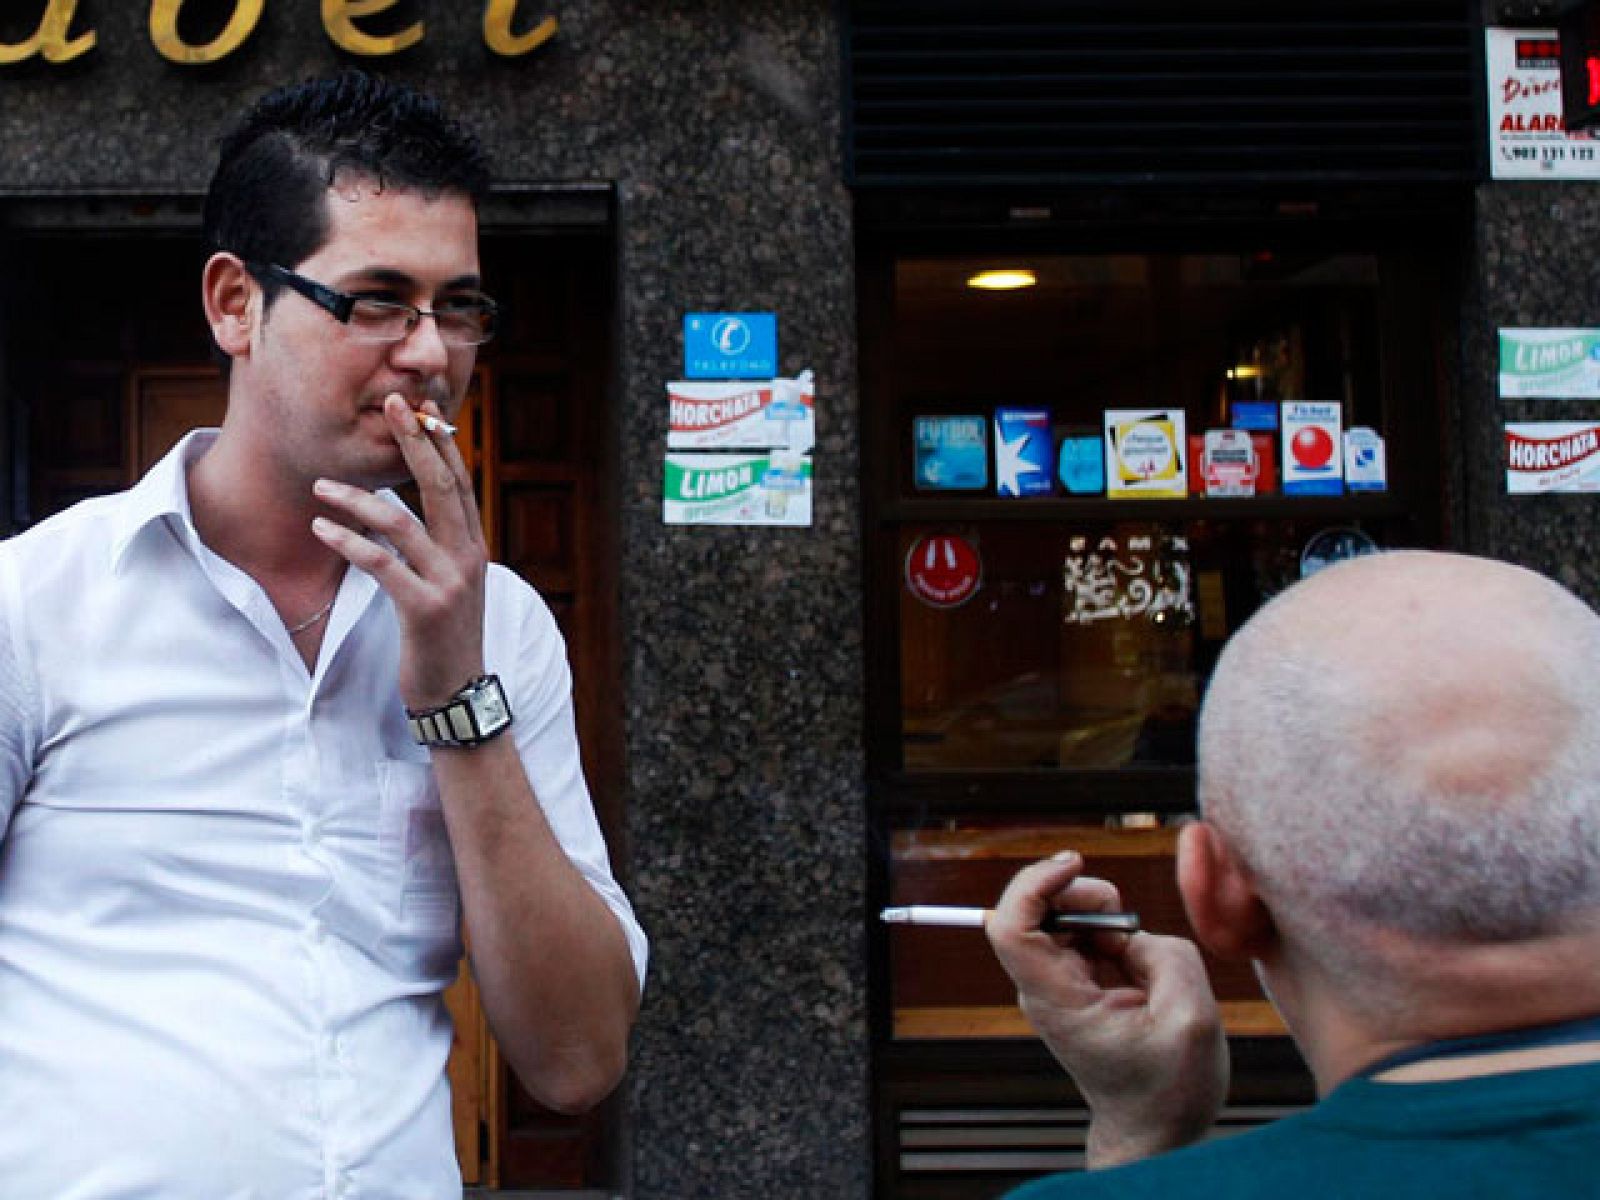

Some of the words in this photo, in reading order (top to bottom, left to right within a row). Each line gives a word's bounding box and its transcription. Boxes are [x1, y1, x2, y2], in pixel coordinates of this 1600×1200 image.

[669, 390, 761, 426] HORCHATA
[1510, 430, 1597, 468] HORCHATA
[680, 464, 753, 498] LIMON
